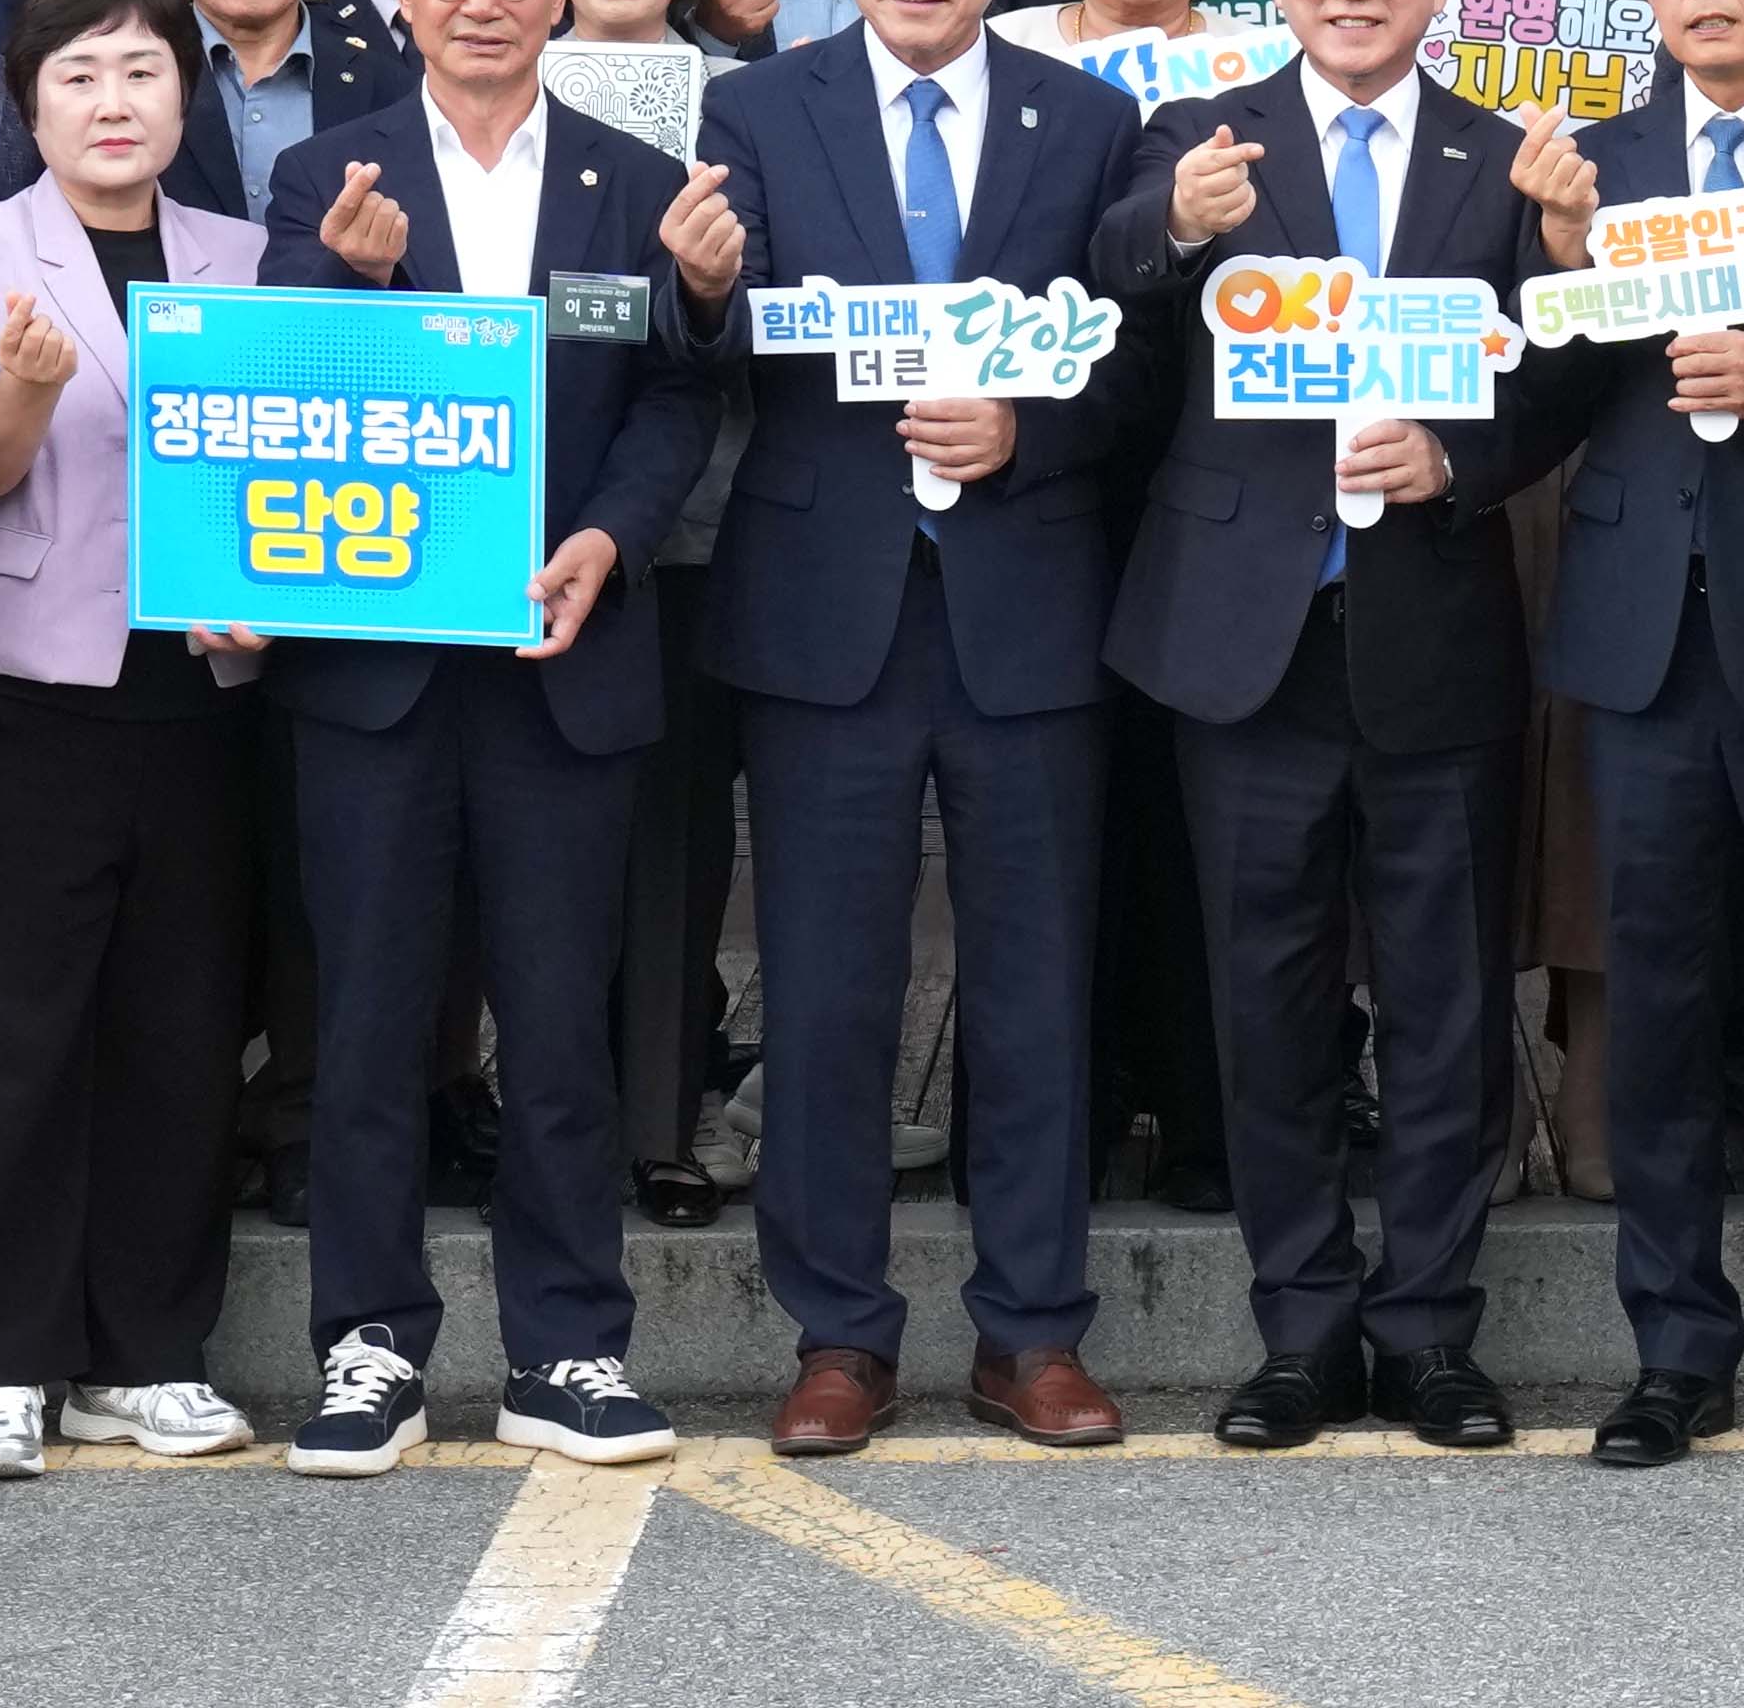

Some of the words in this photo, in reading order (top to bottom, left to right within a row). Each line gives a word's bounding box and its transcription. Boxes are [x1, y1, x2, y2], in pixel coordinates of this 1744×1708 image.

[1449, 40, 1628, 120] 지사님
[762, 290, 837, 341] 힘찬
[847, 298, 932, 344] 미래,
[1215, 268, 1354, 334] OK!
[1357, 292, 1483, 334] 지금은
[1534, 258, 1742, 335] 5백만시대
[849, 348, 883, 386] 더
[893, 348, 928, 386] 큰
[943, 289, 1109, 387] 담양
[1227, 342, 1480, 405] 전남시대
[150, 392, 353, 463] 정원문화
[361, 398, 511, 469] 중심지
[246, 479, 420, 579] 담양
